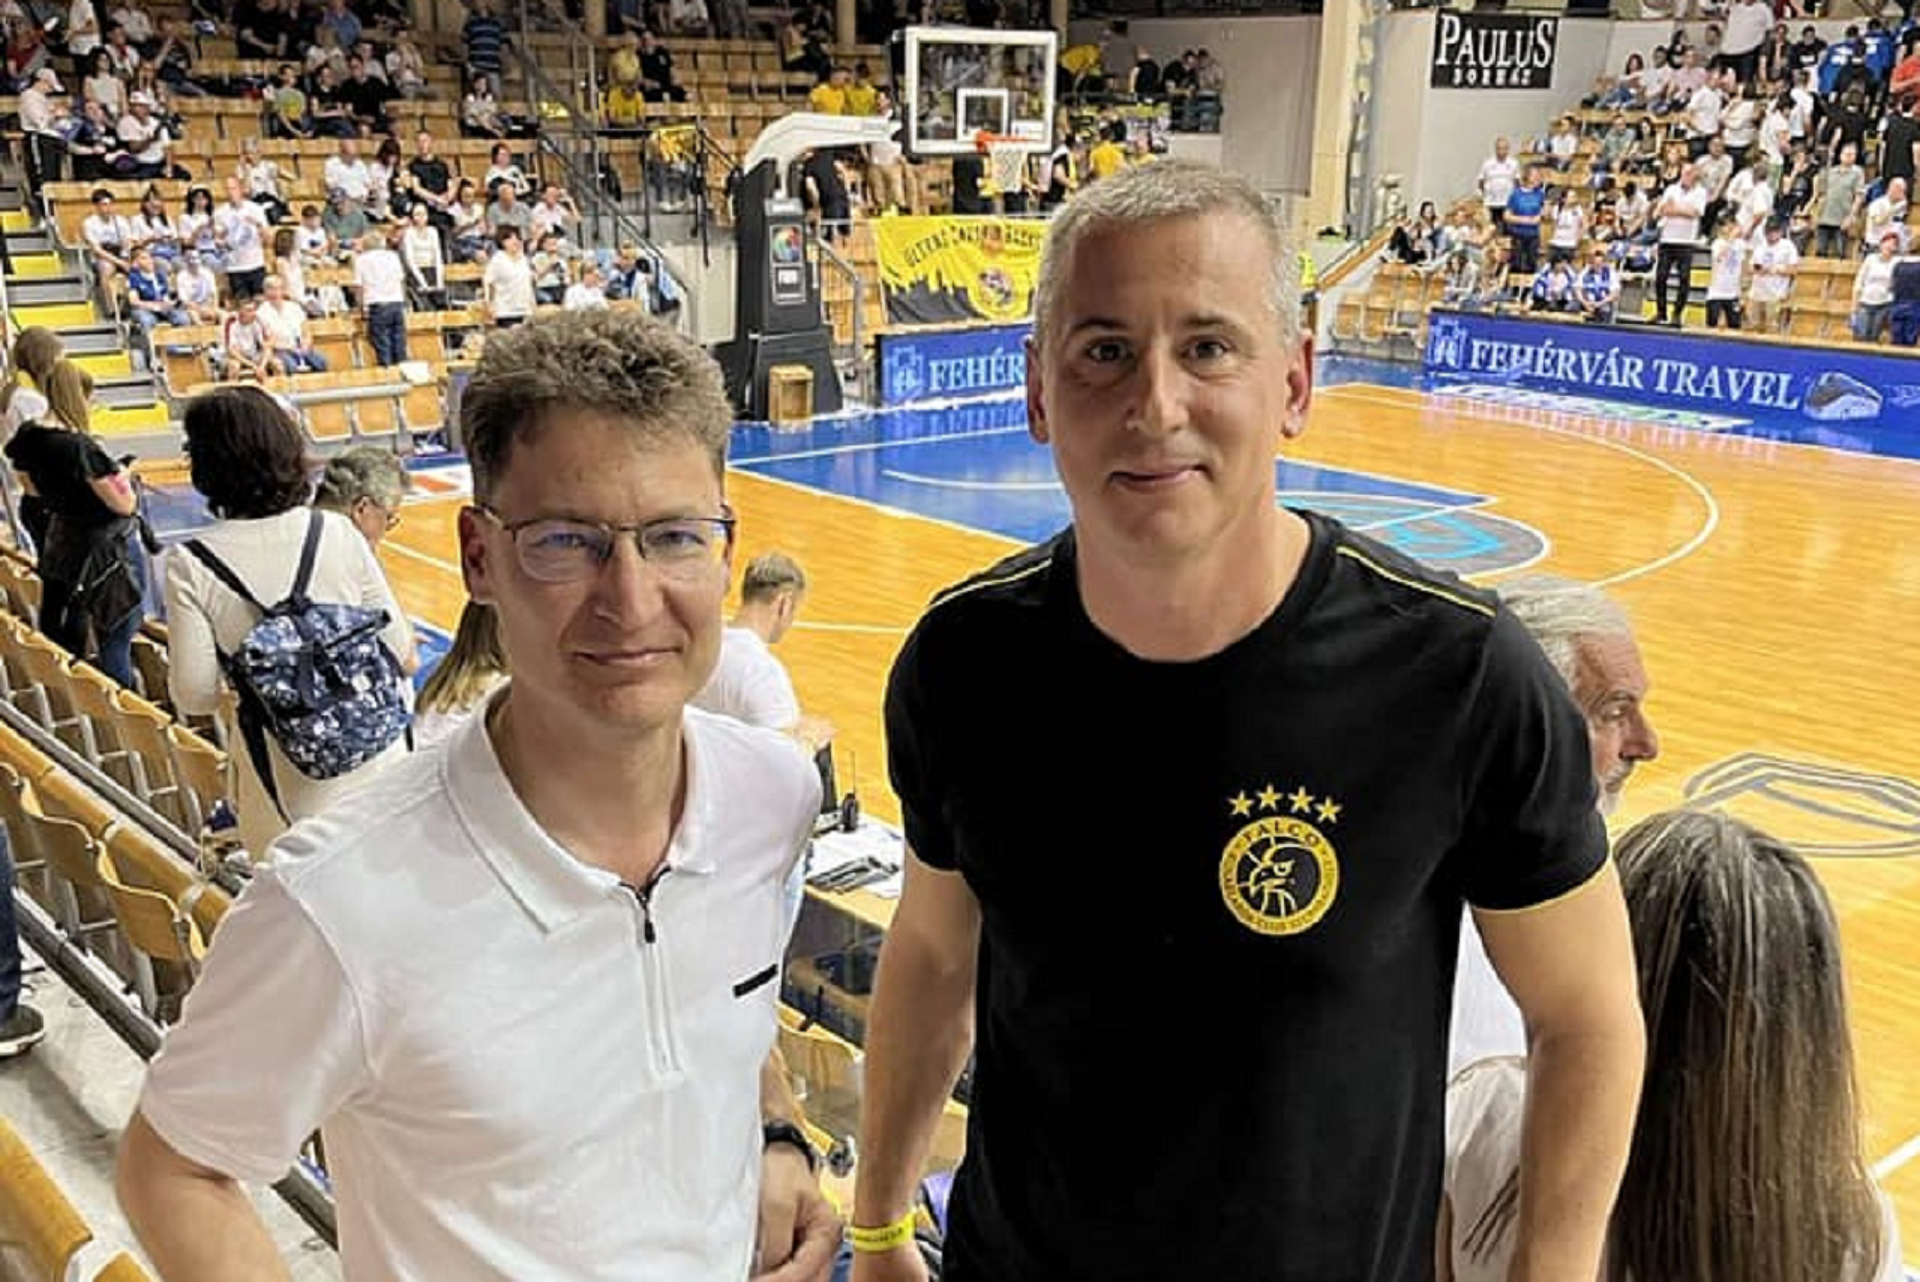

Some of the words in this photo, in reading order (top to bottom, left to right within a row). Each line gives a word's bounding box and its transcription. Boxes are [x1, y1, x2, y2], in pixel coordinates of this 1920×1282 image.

[1435, 15, 1554, 68] PAULUS
[1470, 338, 1645, 390] FEHÉRVÁR
[1652, 358, 1799, 410] TRAVEL
[1239, 819, 1320, 847] FALCO
